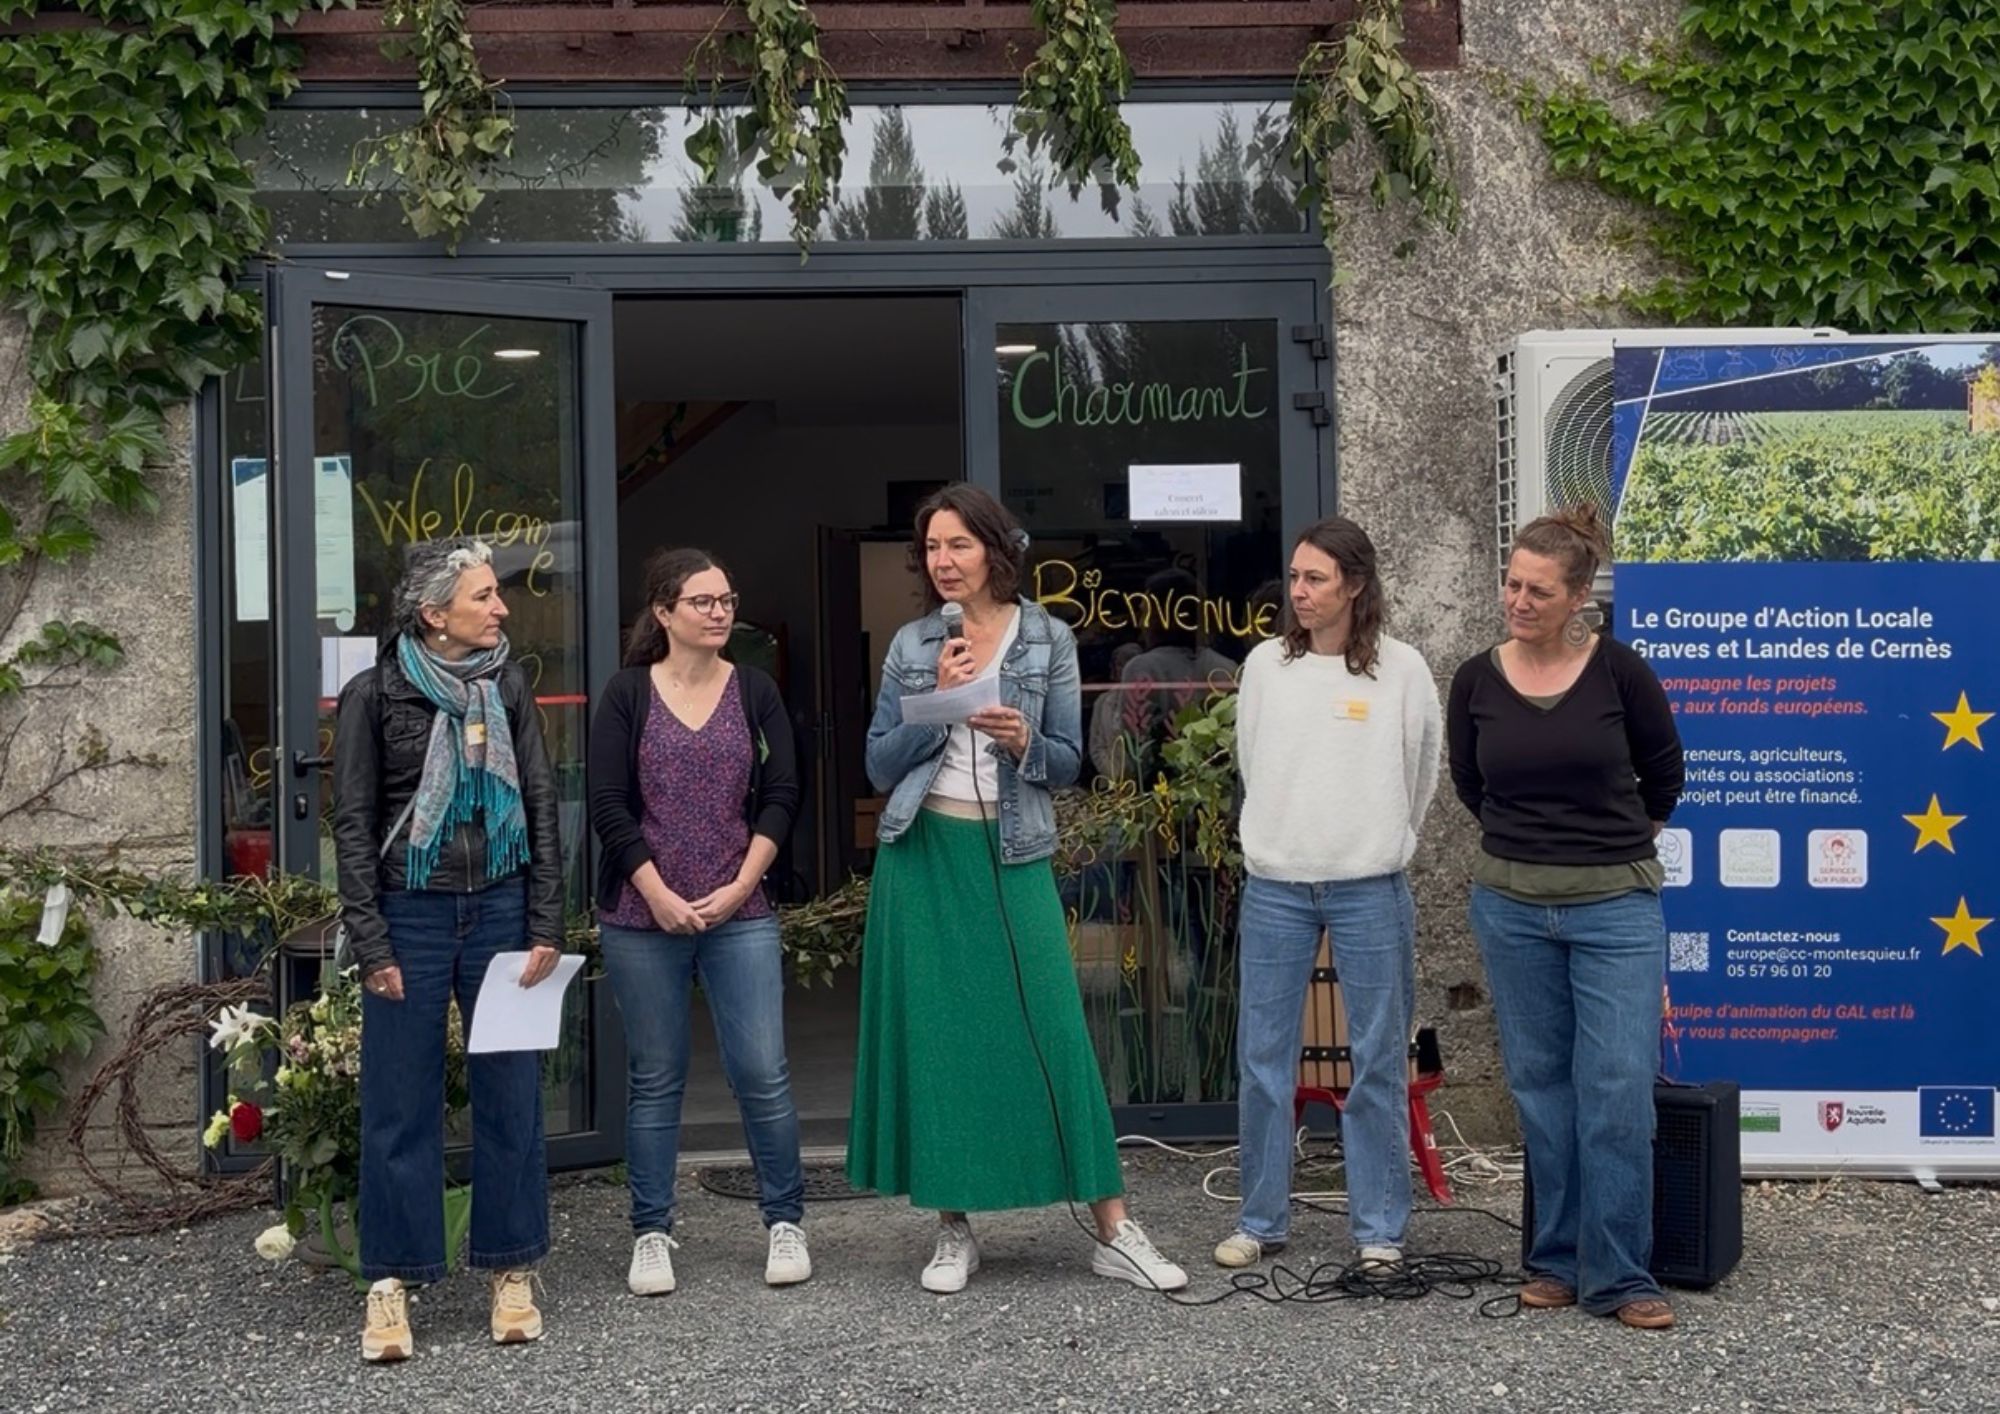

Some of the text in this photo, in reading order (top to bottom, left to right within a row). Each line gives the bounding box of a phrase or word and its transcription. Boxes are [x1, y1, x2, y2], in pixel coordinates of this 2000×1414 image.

[332, 314, 515, 407] Pré
[1011, 342, 1269, 429] Charmant
[1631, 606, 1934, 634] Le Groupe d'Action Locale
[1631, 637, 1952, 659] Graves et Landes de Cernès
[1660, 674, 1836, 696] ompagne les projets
[1684, 701, 1716, 714] aux
[1720, 697, 1769, 714] fonds
[1773, 699, 1869, 717] européens.
[1683, 748, 1848, 765] reneurs, agriculteurs,
[1729, 770, 1750, 783] ou
[1754, 768, 1854, 783] associations
[1725, 789, 1761, 806] peut
[1765, 787, 1796, 804] être
[1800, 787, 1862, 804] financé.
[1726, 929, 1841, 943] Contactez-nous
[1727, 946, 1921, 964] europe@cc-montesquieu.fr
[1727, 965, 1832, 977] 05 57 96 01 20
[1716, 1004, 1807, 1019] d'animation
[1811, 1005, 1831, 1019] du
[1835, 1005, 1868, 1019] GAL
[1871, 1007, 1896, 1019] est
[1899, 1004, 1914, 1019] là
[1689, 1026, 1726, 1039] vous
[1730, 1027, 1839, 1043] accompagner.
